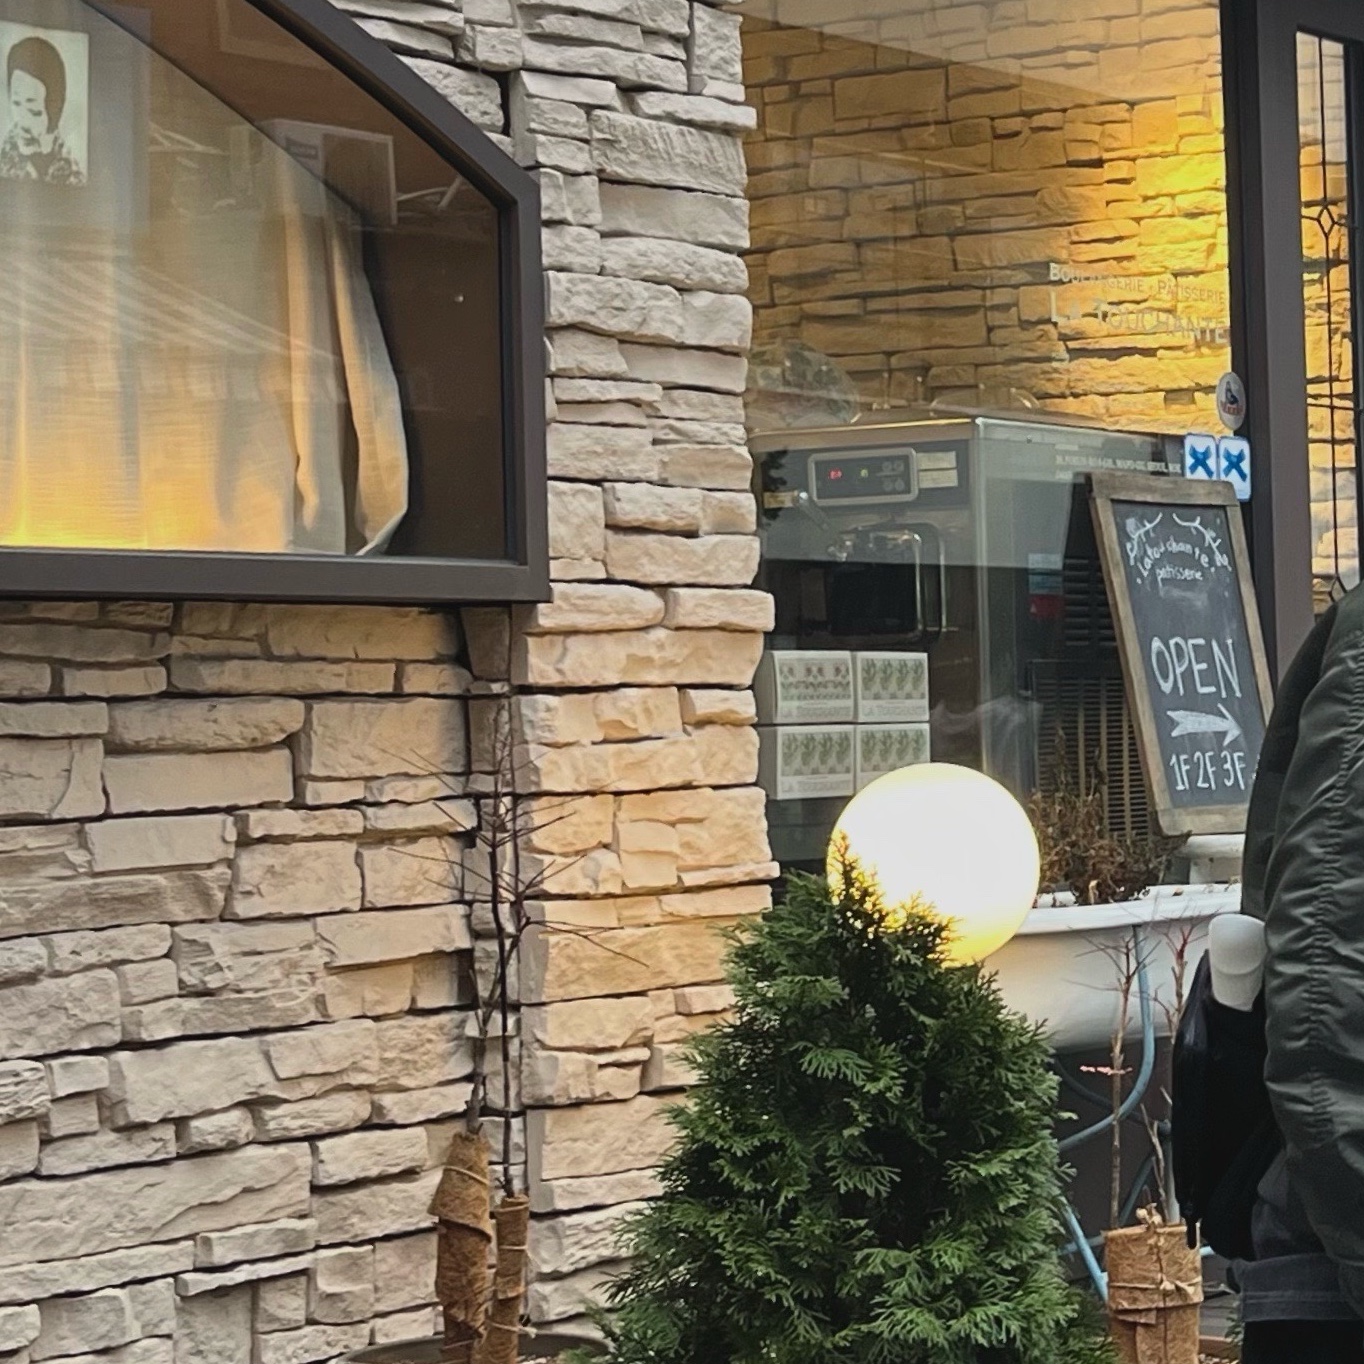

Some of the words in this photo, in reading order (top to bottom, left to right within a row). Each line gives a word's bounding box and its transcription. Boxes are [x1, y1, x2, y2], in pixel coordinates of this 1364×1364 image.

[1151, 636, 1242, 698] OPEN
[1169, 754, 1190, 791] 1F
[1193, 751, 1216, 790] 2F
[1221, 751, 1246, 790] 3F
